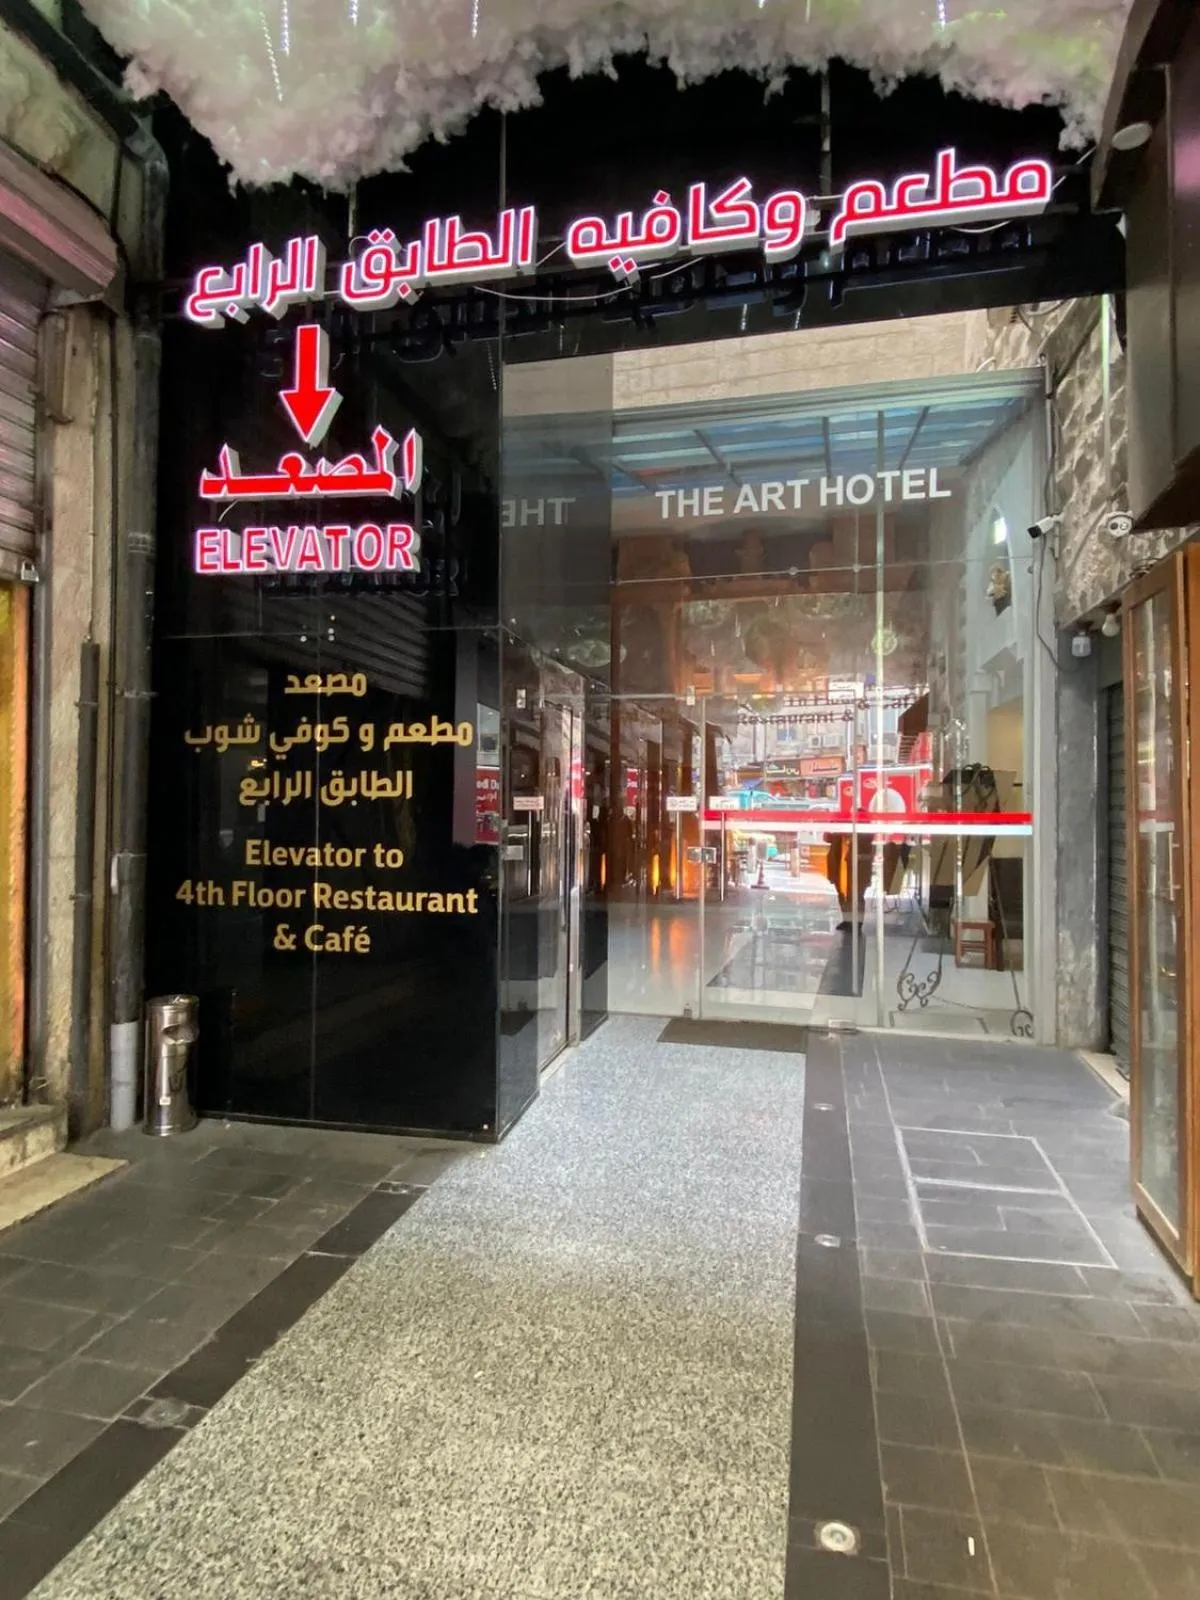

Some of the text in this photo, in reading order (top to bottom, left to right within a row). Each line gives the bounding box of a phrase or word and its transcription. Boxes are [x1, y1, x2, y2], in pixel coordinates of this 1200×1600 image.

[186, 148, 1052, 322] مطعم وكافيه الطابق الرابع
[201, 425, 419, 499] المصعد
[655, 467, 952, 520] THE ART HOTEL
[196, 524, 417, 574] ELEVATOR
[284, 671, 367, 697] مصعد
[184, 712, 474, 760] مطعم و كوفي شوب
[239, 770, 414, 806] الطابق الرابع
[245, 839, 404, 868] Elevator to
[175, 880, 479, 914] 4th Floor Restaurant
[273, 923, 371, 953] & Café
